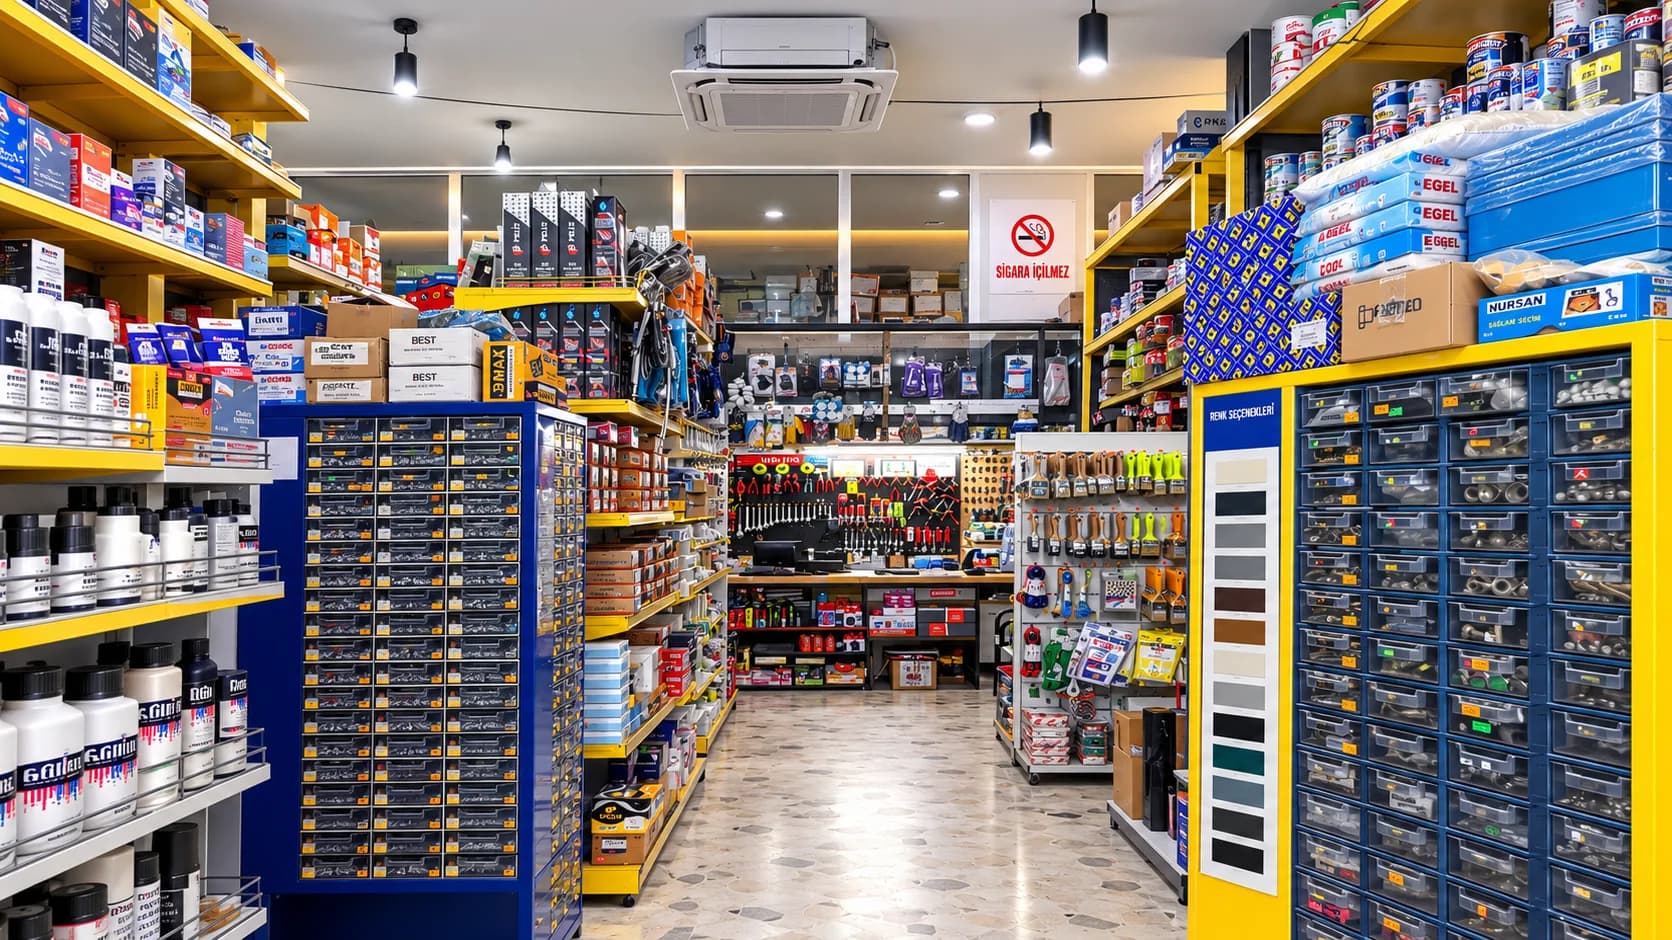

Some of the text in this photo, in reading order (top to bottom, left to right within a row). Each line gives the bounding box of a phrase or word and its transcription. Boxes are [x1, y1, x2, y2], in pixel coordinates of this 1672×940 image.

[1423, 177, 1459, 194] EGEL
[1423, 207, 1458, 222] EGEL
[996, 262, 1070, 281] SİGARA İÇİLMEZ
[1489, 295, 1543, 313] NURSAN
[411, 336, 437, 345] BEST
[412, 372, 437, 381] BEST
[1210, 402, 1274, 421] RENK SEÇENEKLERİ
